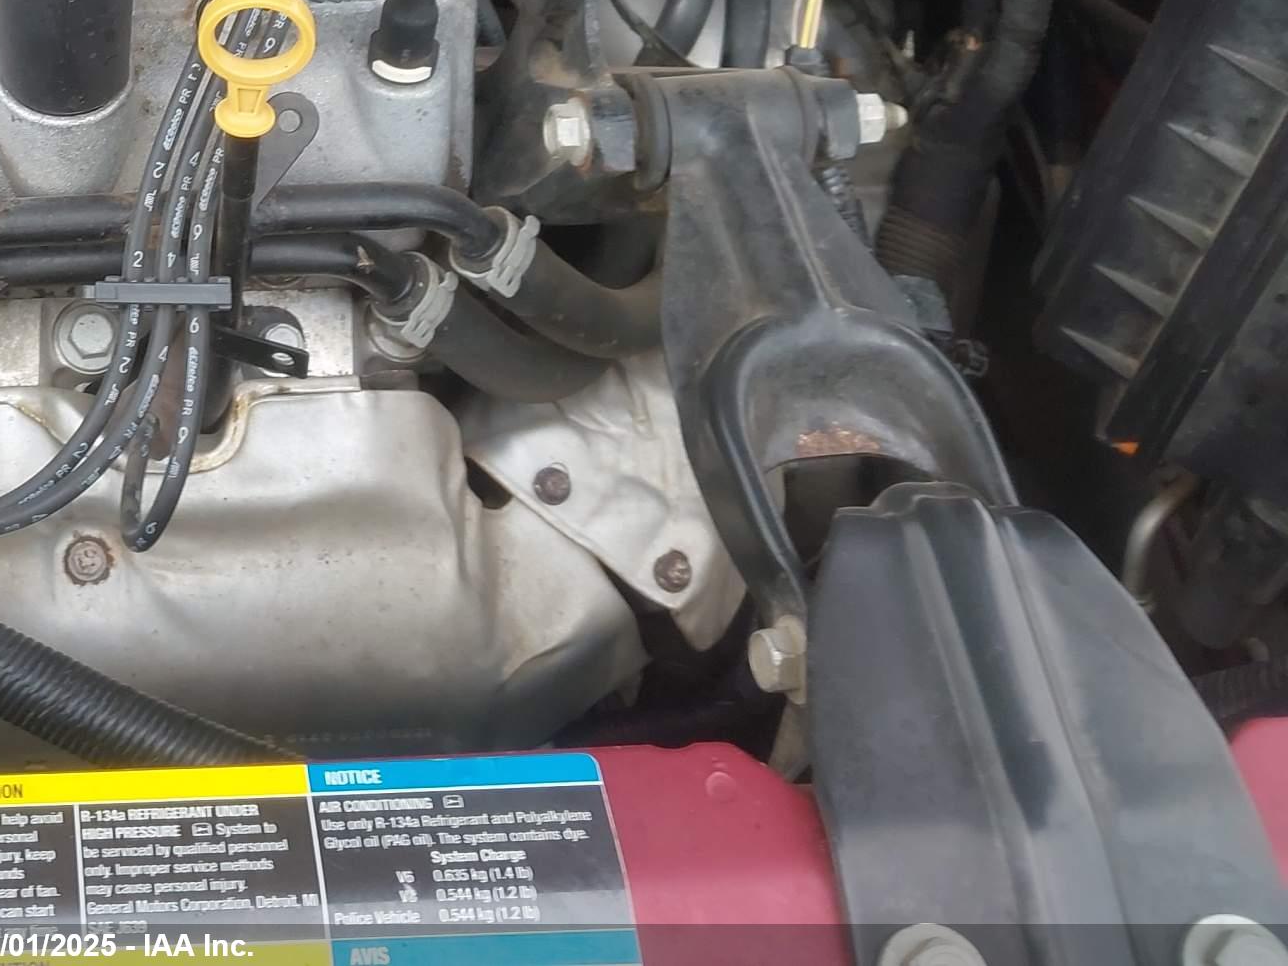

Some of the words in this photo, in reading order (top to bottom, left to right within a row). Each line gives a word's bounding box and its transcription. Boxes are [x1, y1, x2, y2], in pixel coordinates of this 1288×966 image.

[179, 88, 193, 105] PR
[213, 147, 225, 164] PR
[181, 176, 193, 191] PR
[132, 250, 144, 268] 2
[125, 331, 138, 348] PR
[181, 399, 194, 416] PR
[324, 769, 383, 785] NOTICE
[80, 810, 127, 822] R-134a
[127, 805, 213, 820] REFRIGERANT
[215, 804, 259, 817] UNDER
[318, 800, 343, 813] AIR
[343, 797, 434, 813] CONDITIONING
[1, 813, 29, 827] help
[30, 811, 63, 824] avoid
[320, 818, 346, 831] Use
[346, 817, 374, 832] only
[374, 815, 421, 829] R-134a
[420, 813, 490, 828] Refrigerant
[490, 811, 516, 824] and
[515, 809, 592, 825] Polyalkylene
[82, 827, 114, 840] HIGH
[114, 824, 182, 839] PRESSURE
[215, 823, 262, 837] System
[263, 822, 278, 834] to
[83, 846, 100, 859] be
[101, 843, 154, 858] serviced
[154, 843, 172, 858] by
[172, 840, 227, 857] qualified
[227, 838, 289, 855] personnel
[323, 835, 363, 852] Glycol
[363, 834, 381, 848] oil
[380, 833, 412, 849] (PAG
[436, 832, 462, 845] The
[462, 831, 509, 846] system
[509, 828, 563, 842] contains
[25, 849, 56, 862] keep
[430, 850, 479, 865] System
[479, 848, 528, 863] Charge
[115, 863, 171, 877] Improper
[172, 859, 219, 873] service
[220, 857, 274, 872] methods
[432, 868, 470, 882] 0.635
[470, 868, 489, 883] kg
[489, 866, 515, 883] (1.4
[515, 866, 534, 881] lb)
[20, 885, 35, 898] of
[85, 884, 113, 898] may
[114, 883, 153, 894] cause
[153, 878, 209, 895] personal
[435, 887, 473, 902] 0.544
[474, 886, 492, 903] kg
[492, 886, 519, 902] (1.2
[519, 885, 538, 901] lb)
[0, 907, 24, 918] can
[24, 904, 56, 917] start
[86, 900, 134, 914] General
[135, 899, 180, 913] Motors
[301, 893, 320, 907] MI
[334, 911, 375, 925] Police
[374, 909, 421, 924] Vehicle
[438, 908, 476, 923] 0.544
[476, 907, 495, 924] kg
[495, 906, 522, 923] (1.2
[522, 905, 541, 922] lb)
[350, 946, 390, 966] AVIS
